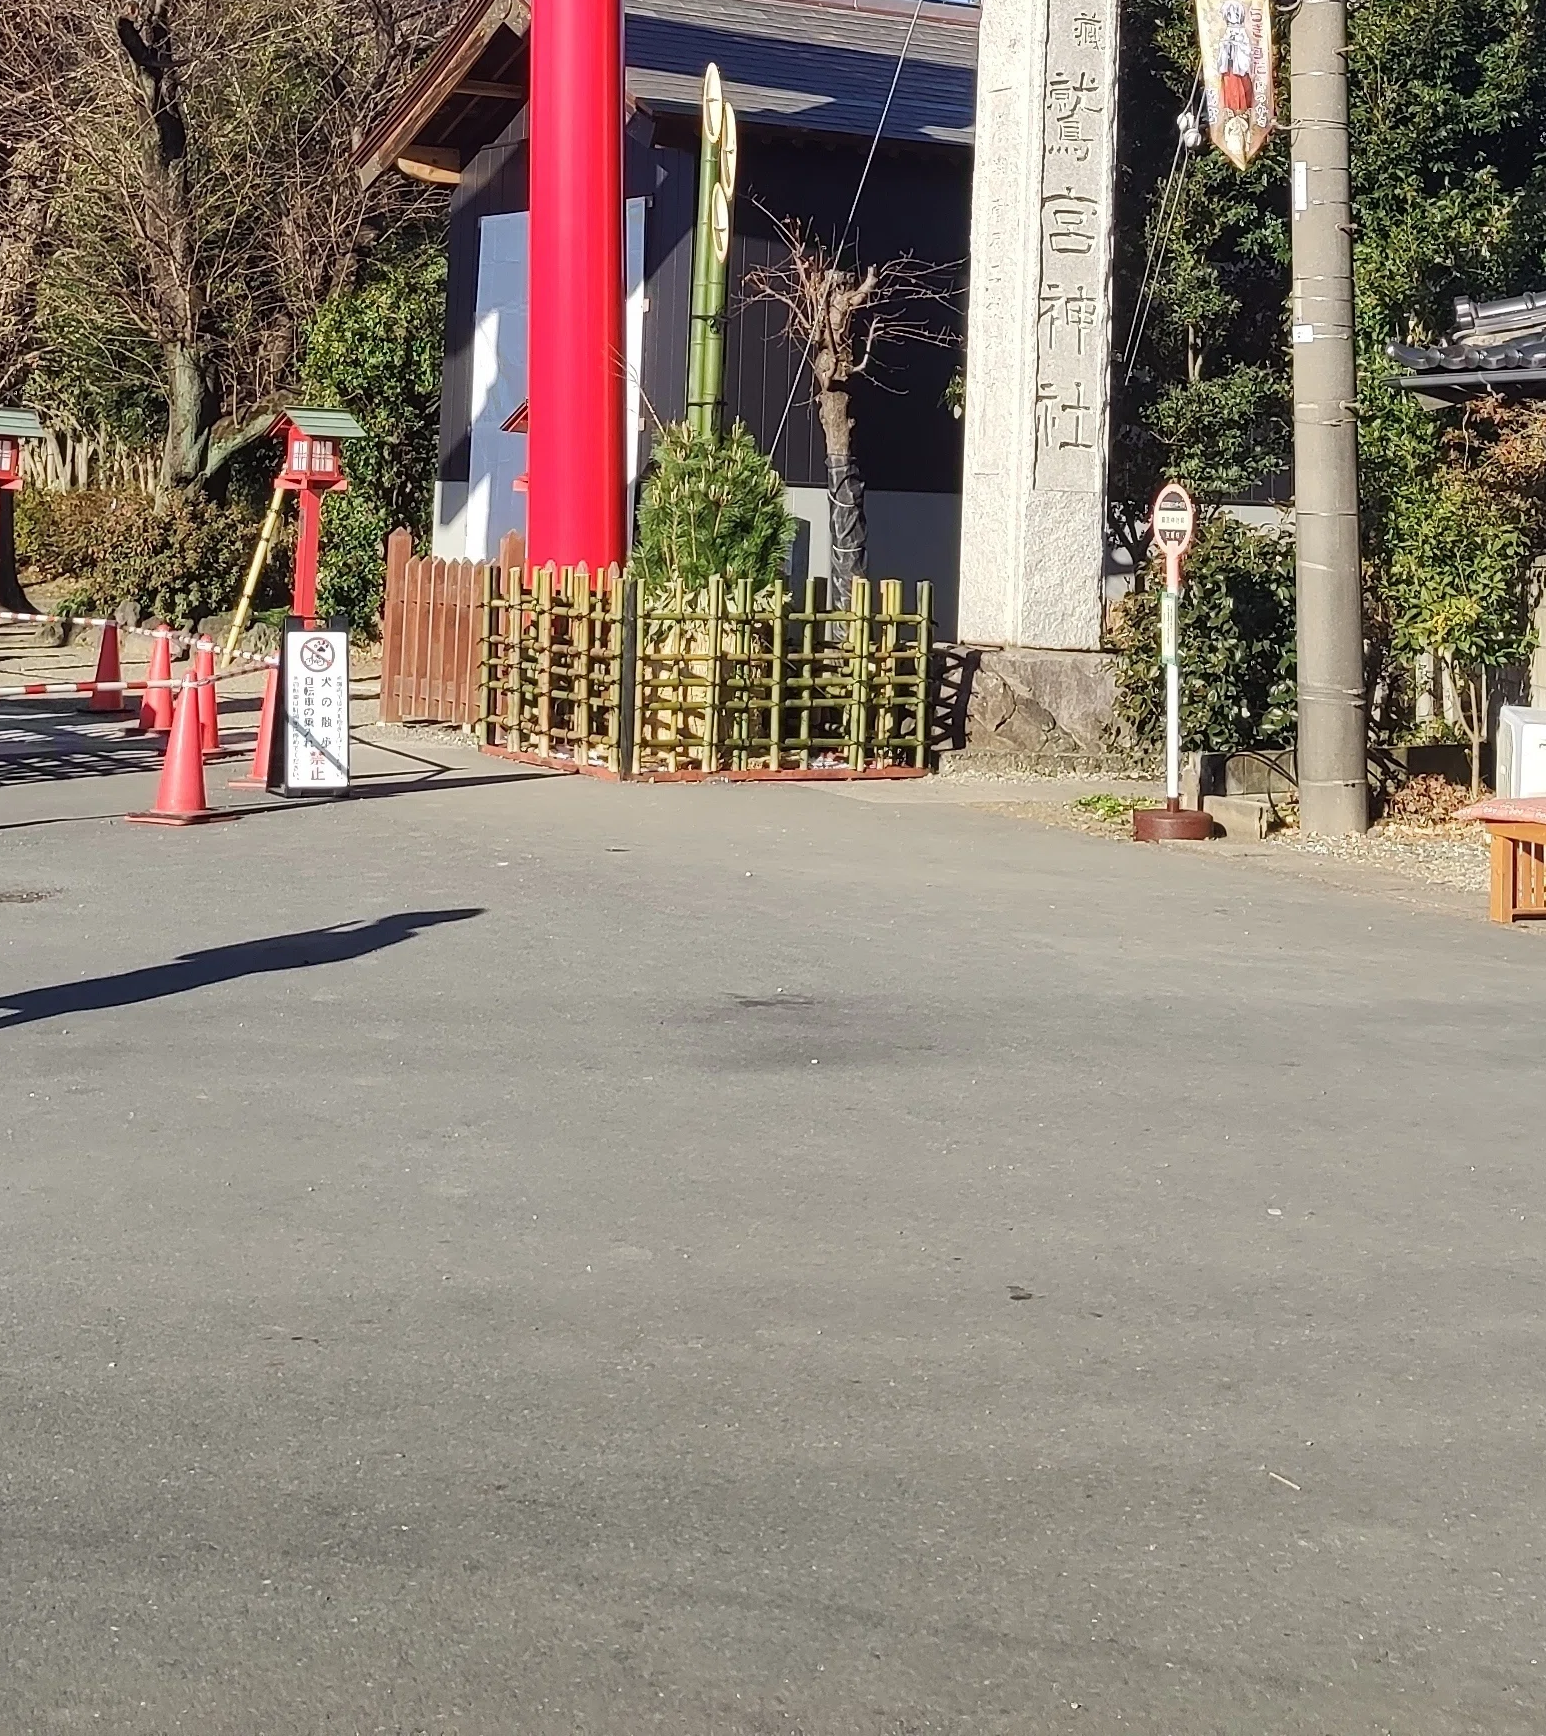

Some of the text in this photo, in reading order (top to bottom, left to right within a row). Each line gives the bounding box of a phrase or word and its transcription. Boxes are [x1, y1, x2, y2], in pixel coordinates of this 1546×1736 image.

[1037, 72, 1104, 449] 鷲宮神社
[321, 676, 332, 748] 犬の散歩
[310, 751, 325, 781] 禁止
